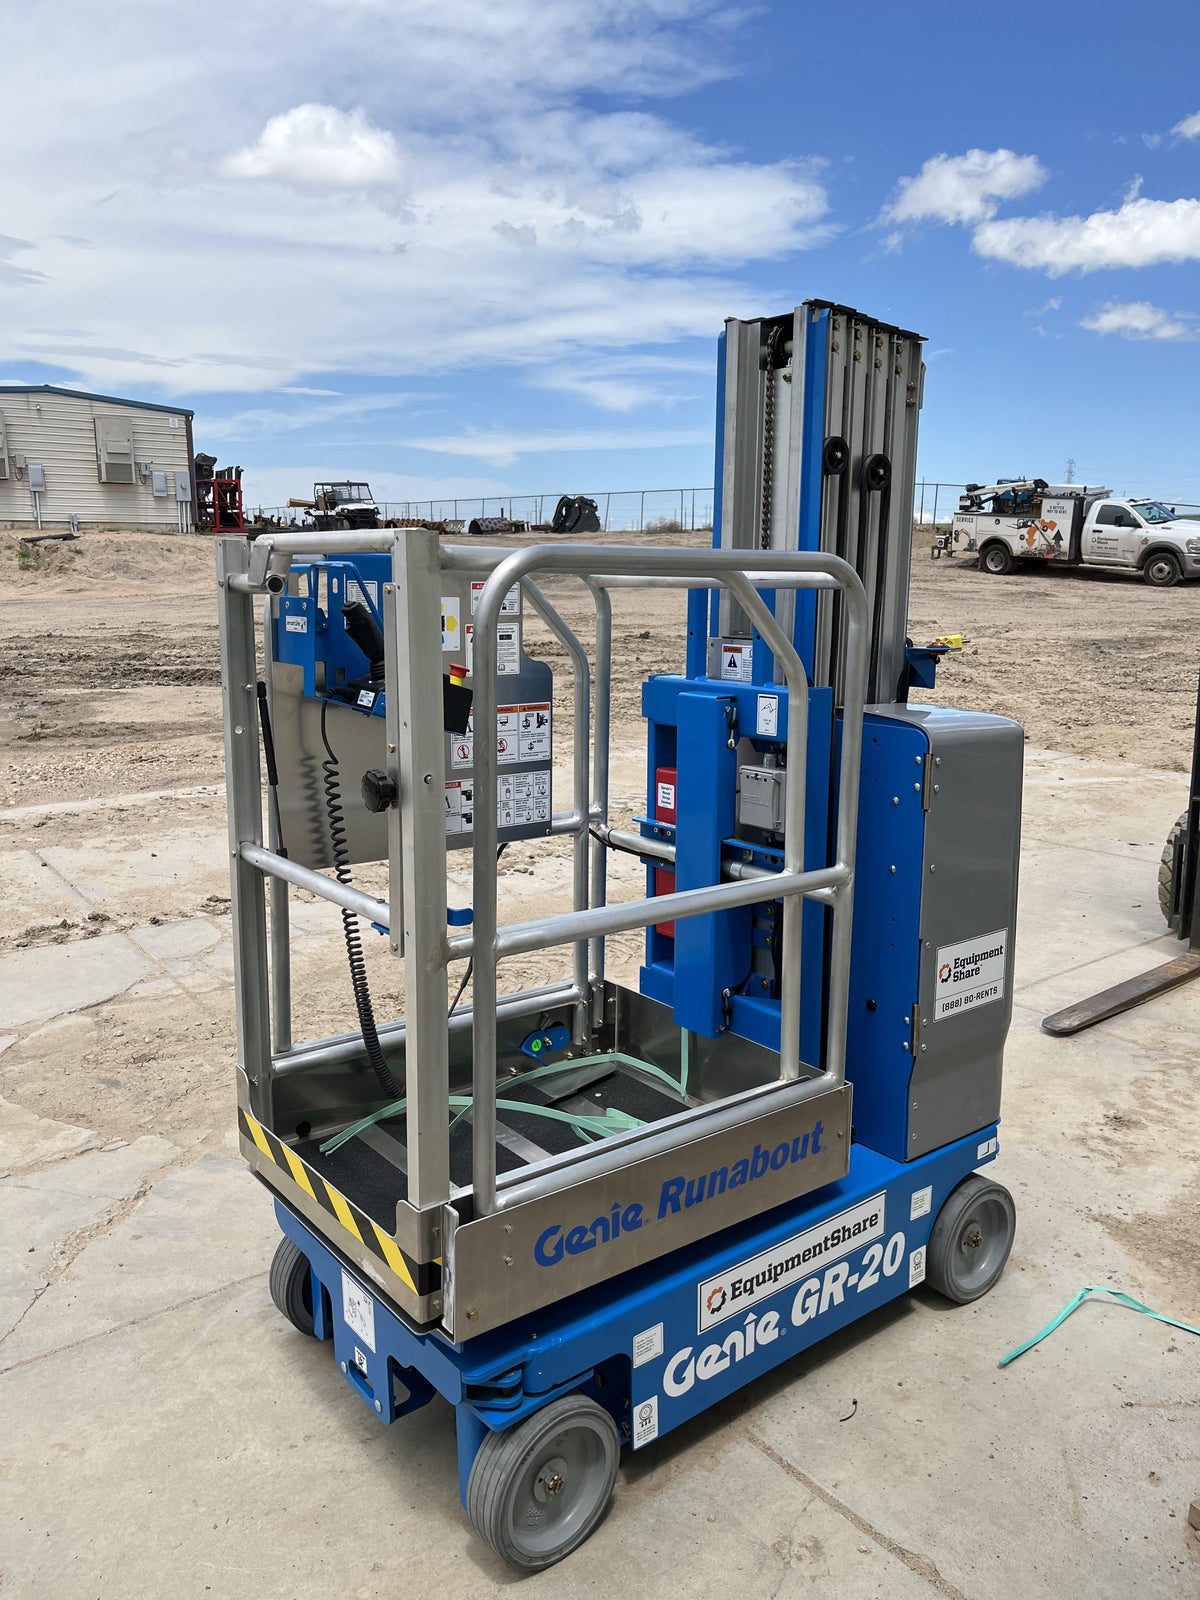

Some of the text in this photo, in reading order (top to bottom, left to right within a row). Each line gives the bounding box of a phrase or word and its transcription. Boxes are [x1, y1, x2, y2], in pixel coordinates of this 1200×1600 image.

[956, 516, 975, 524] SERVICE
[953, 944, 1004, 970] Equipment
[952, 966, 980, 983] Share
[942, 986, 998, 1012] (888) 80-RENTS
[534, 1120, 825, 1267] Genie Runabout
[730, 1212, 879, 1302] EquipmentShare
[663, 1231, 906, 1397] Genie GR-20
